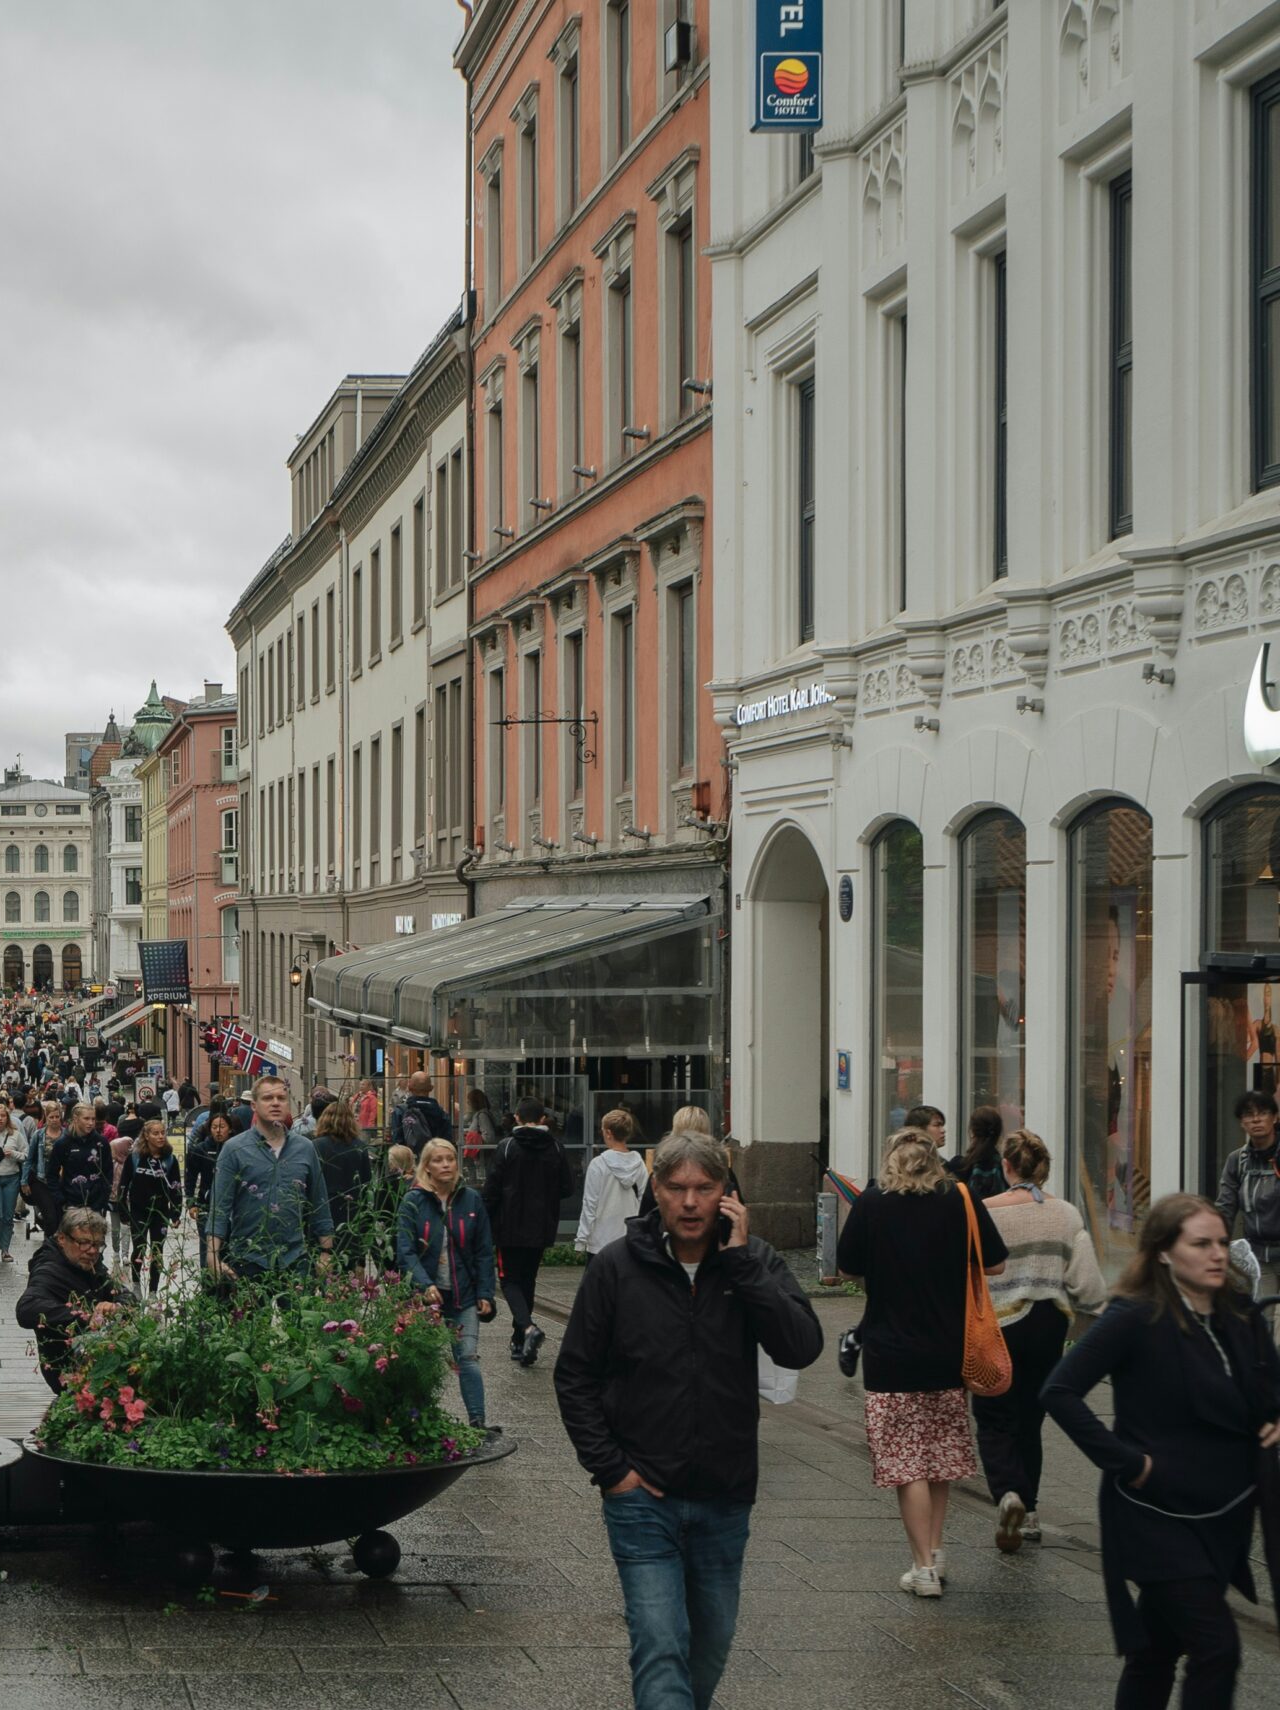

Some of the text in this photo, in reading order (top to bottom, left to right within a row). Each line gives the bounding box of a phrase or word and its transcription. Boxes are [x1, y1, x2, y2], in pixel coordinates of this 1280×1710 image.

[780, 0, 804, 38] EL
[766, 93, 816, 107] Comfort
[774, 106, 808, 116] HOTEL
[810, 683, 837, 707] JOHA
[147, 992, 187, 1002] XPERIUM
